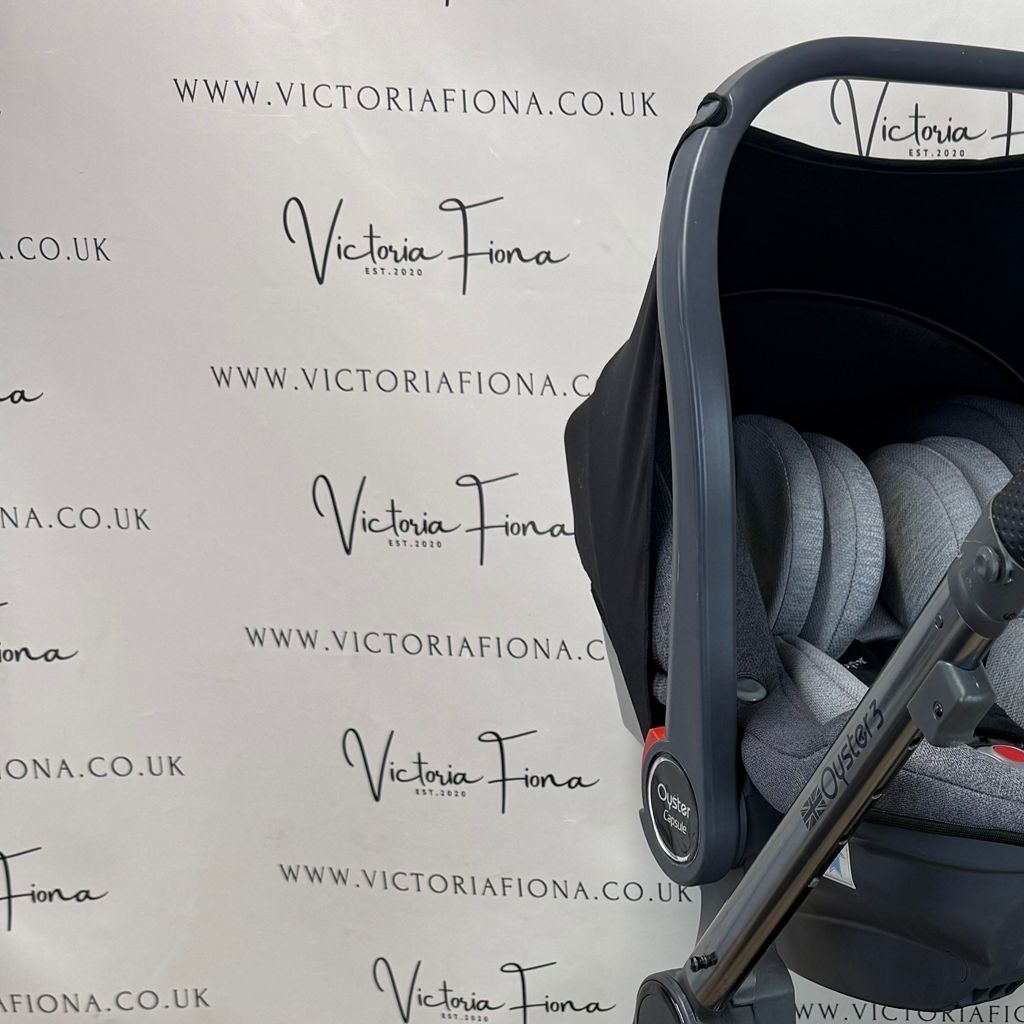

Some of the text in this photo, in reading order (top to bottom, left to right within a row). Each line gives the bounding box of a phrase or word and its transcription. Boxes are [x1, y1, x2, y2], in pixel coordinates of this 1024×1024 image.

[173, 78, 658, 118] WWW.VICTORIAFIONA.CO.UK
[830, 79, 987, 157] Victoria
[909, 149, 965, 158] EST.2020
[0, 236, 111, 262] .CO.UK
[282, 196, 570, 295] Victoria Fiona
[364, 266, 424, 277] EST.2020
[210, 365, 600, 398] WWW.VICTORIAFIONA.C
[312, 472, 576, 566] Victoria Fiona
[388, 539, 443, 549] EST.2020
[342, 728, 601, 814] Victoria Fiona
[415, 788, 467, 798] EST.2020
[657, 783, 691, 818] Oyster
[663, 809, 687, 835] Capsule
[0, 847, 109, 932] Fiona
[279, 863, 694, 903] WWW.VICTORIAFIONA.CO.UK
[373, 957, 506, 1024] Victoria
[440, 1012, 490, 1023] EST.2020
